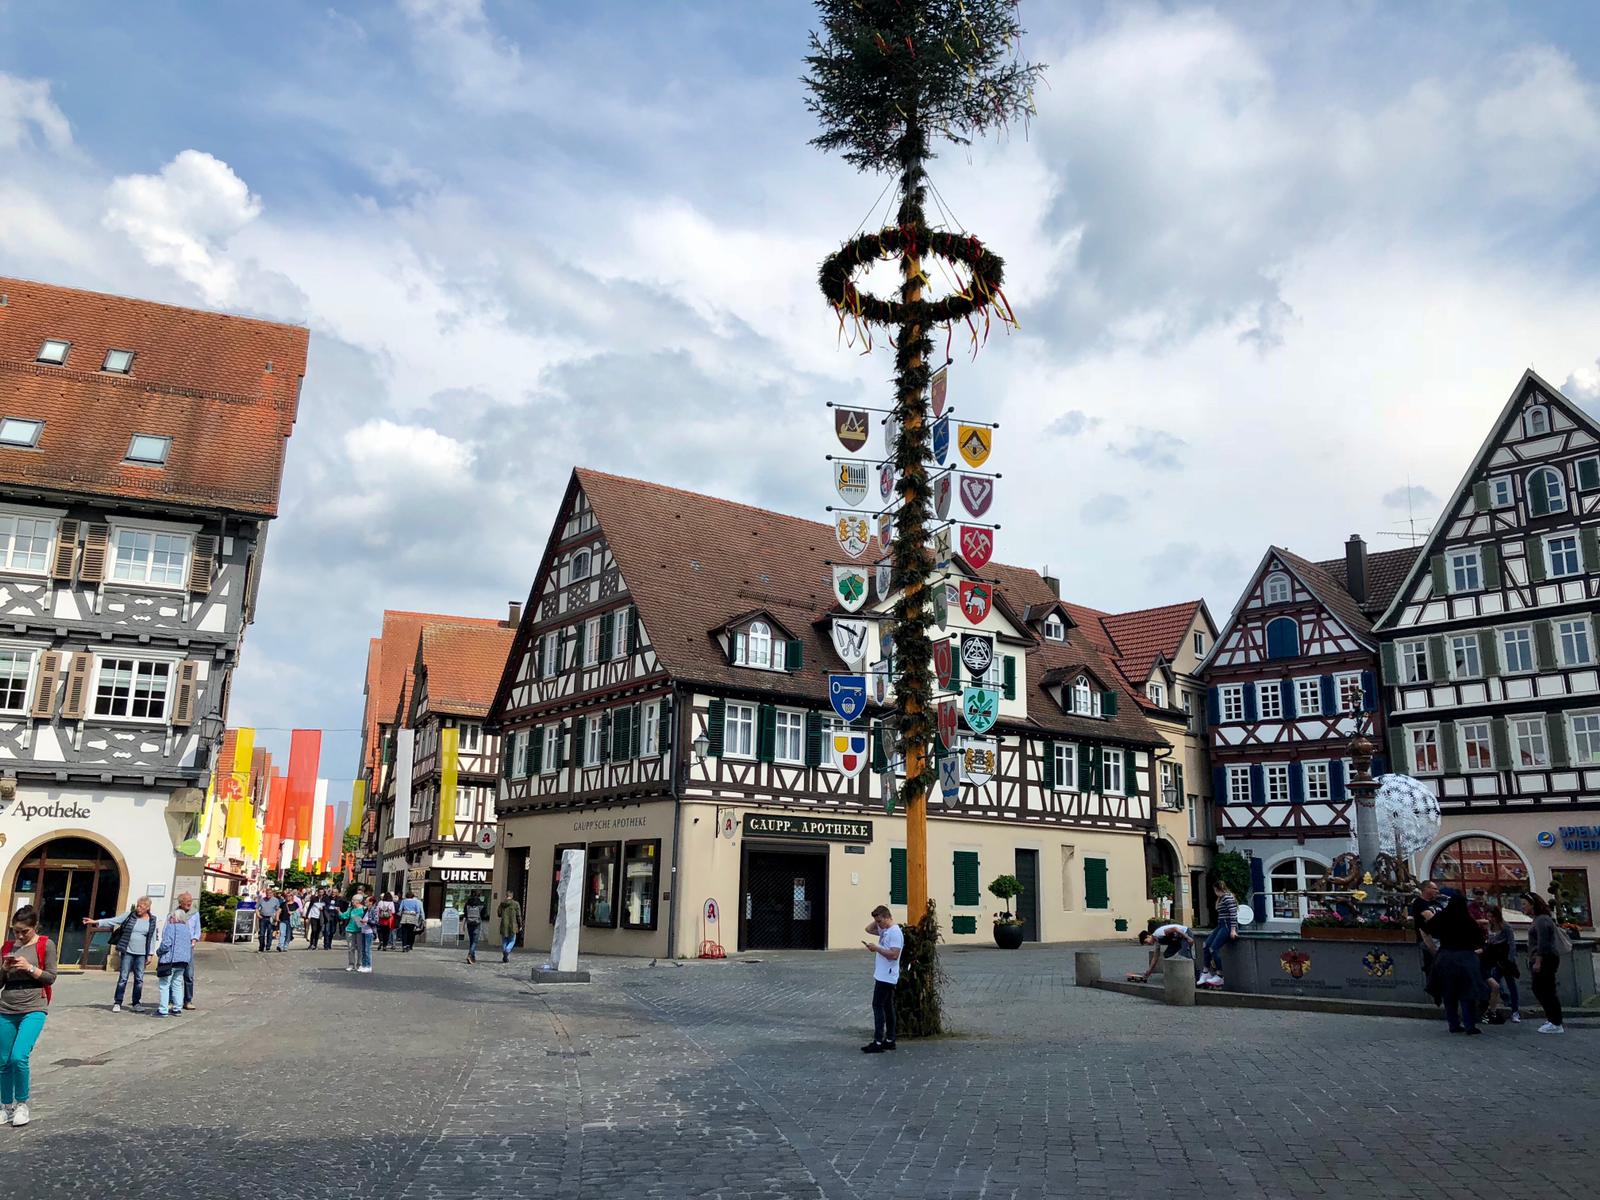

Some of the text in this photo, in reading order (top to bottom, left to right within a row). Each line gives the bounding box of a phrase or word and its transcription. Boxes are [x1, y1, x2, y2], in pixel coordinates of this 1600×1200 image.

[12, 800, 91, 821] Apotheke
[613, 816, 647, 828] APOTHEKE
[801, 821, 868, 836] APOTHEKE
[441, 870, 487, 881] UHREN
